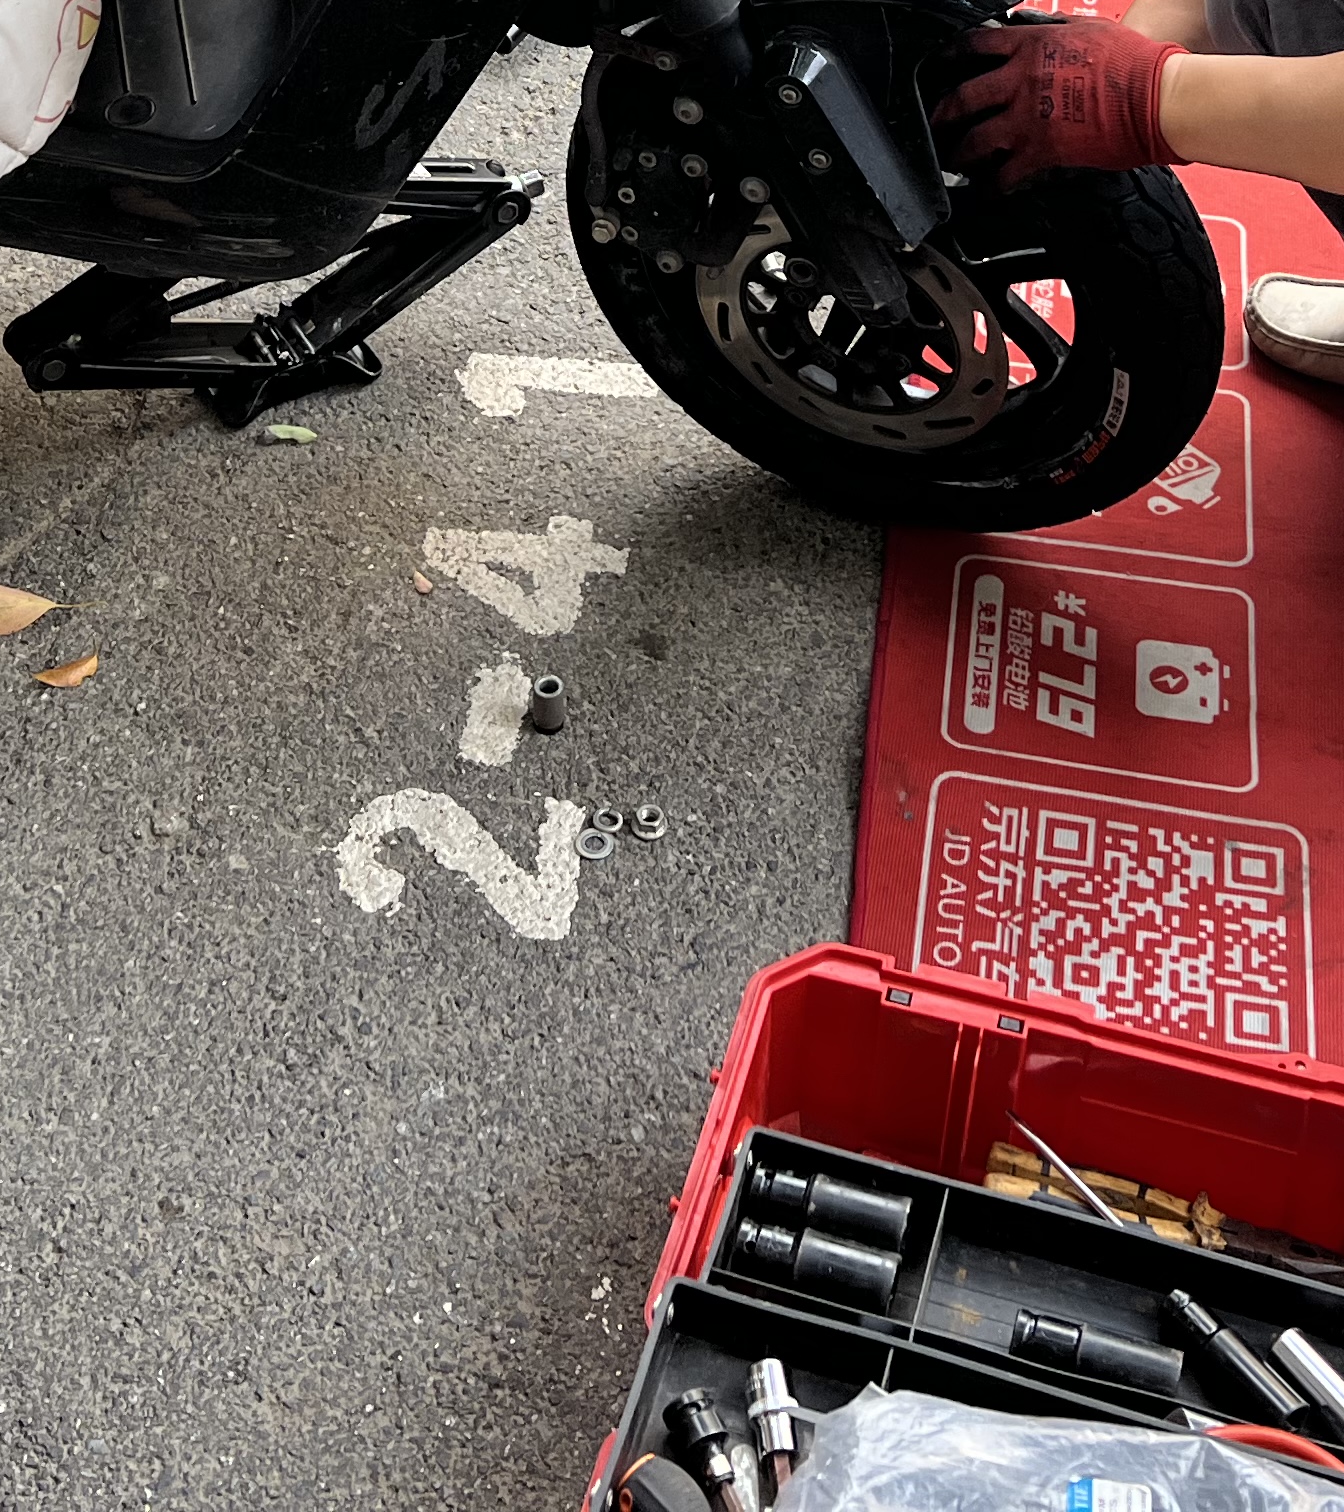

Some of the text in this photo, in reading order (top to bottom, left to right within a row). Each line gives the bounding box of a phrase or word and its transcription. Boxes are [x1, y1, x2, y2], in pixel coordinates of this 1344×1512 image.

[970, 601, 997, 709] 免费上门安装
[1002, 606, 1034, 711] 铅酸电池
[933, 829, 971, 968] JD AUTO
